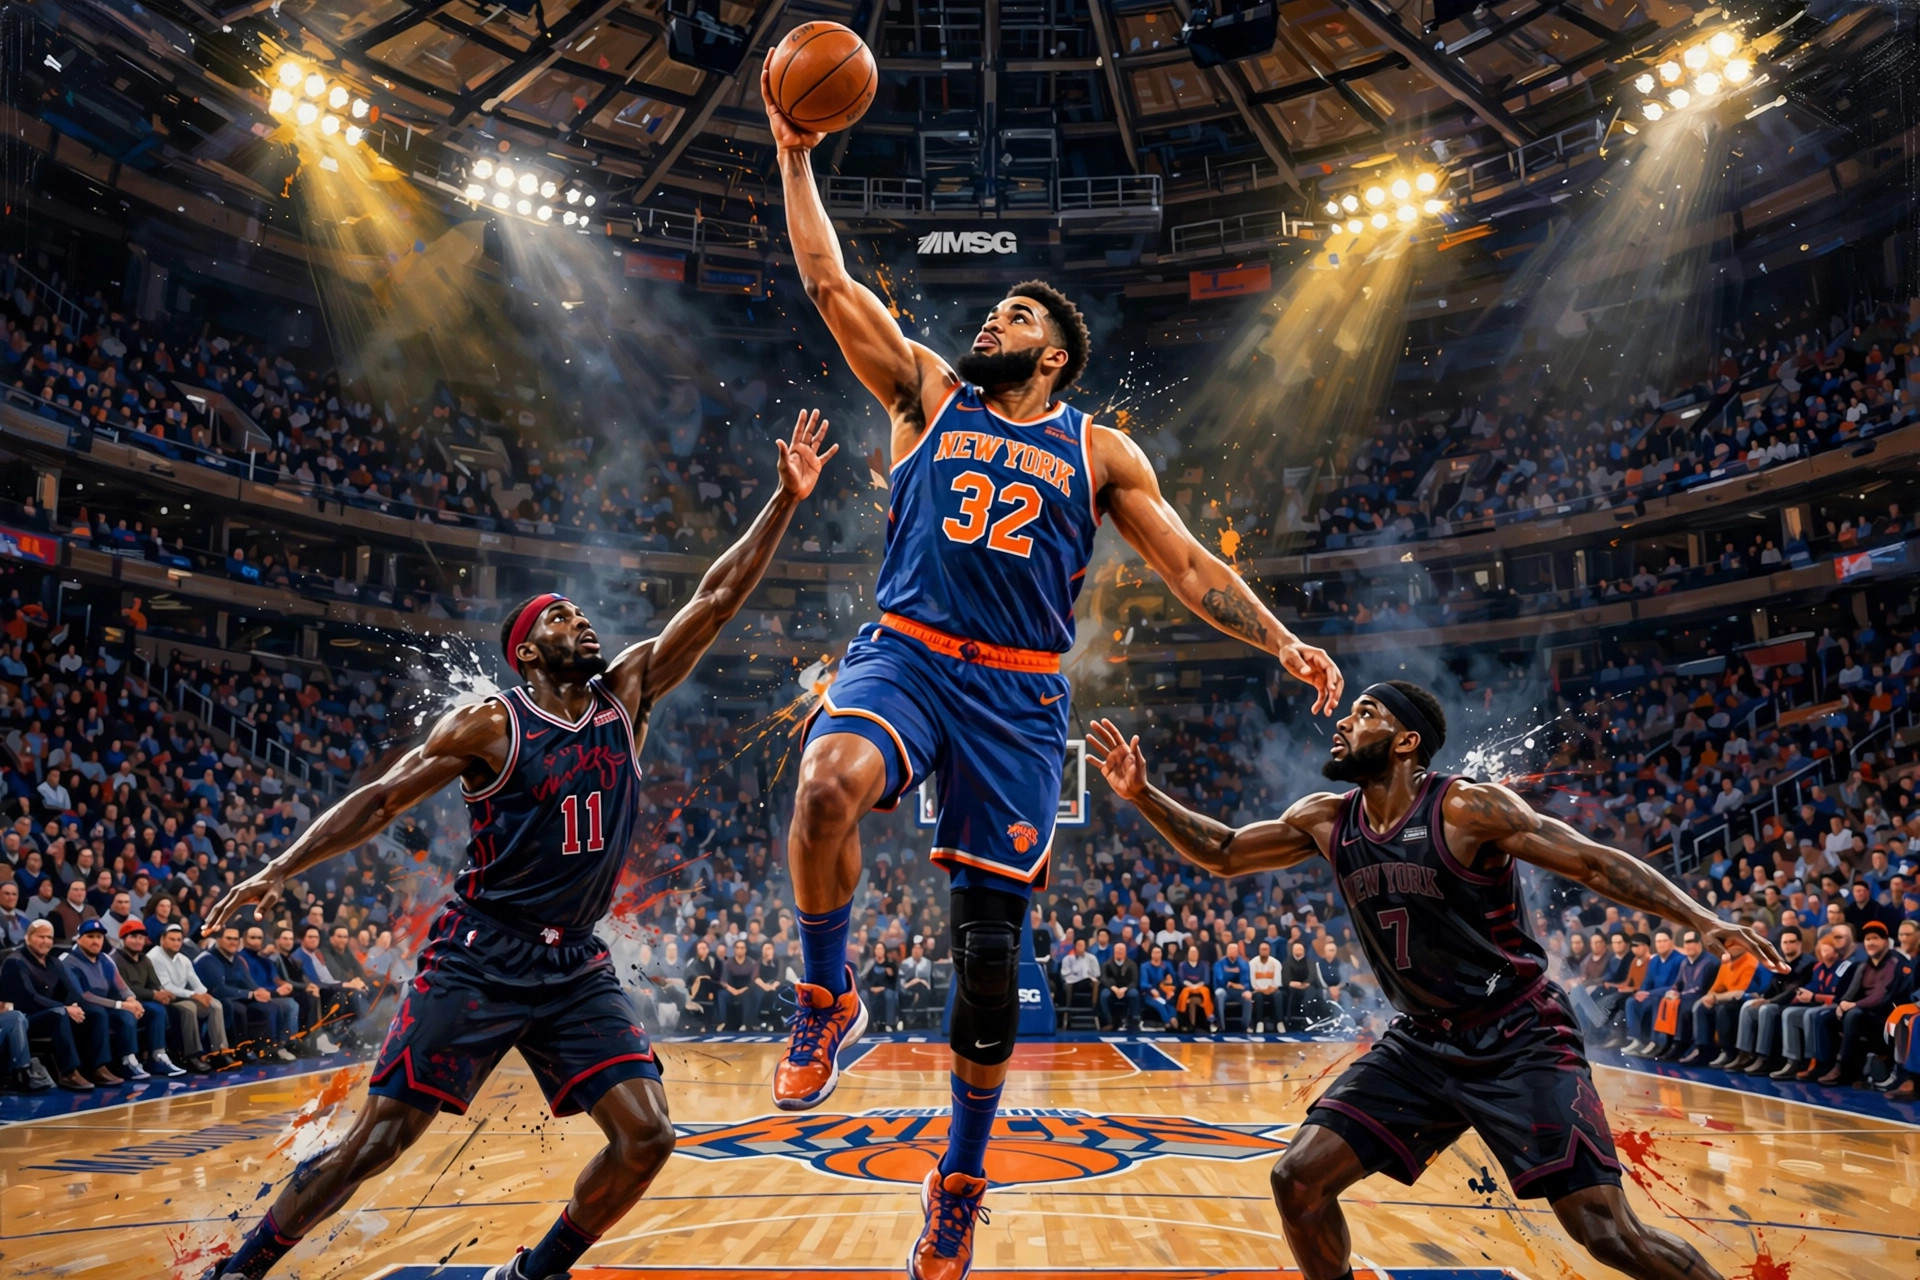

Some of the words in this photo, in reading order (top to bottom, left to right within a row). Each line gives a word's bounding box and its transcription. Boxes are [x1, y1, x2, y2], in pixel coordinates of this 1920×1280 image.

[941, 230, 1018, 255] MSG
[933, 430, 1004, 463] NEW
[1004, 439, 1076, 498] YORK
[941, 469, 1044, 559] 32
[560, 790, 605, 856] 11
[1380, 861, 1445, 900] YORK
[1376, 906, 1412, 971] 7
[1017, 988, 1042, 1003] SG
